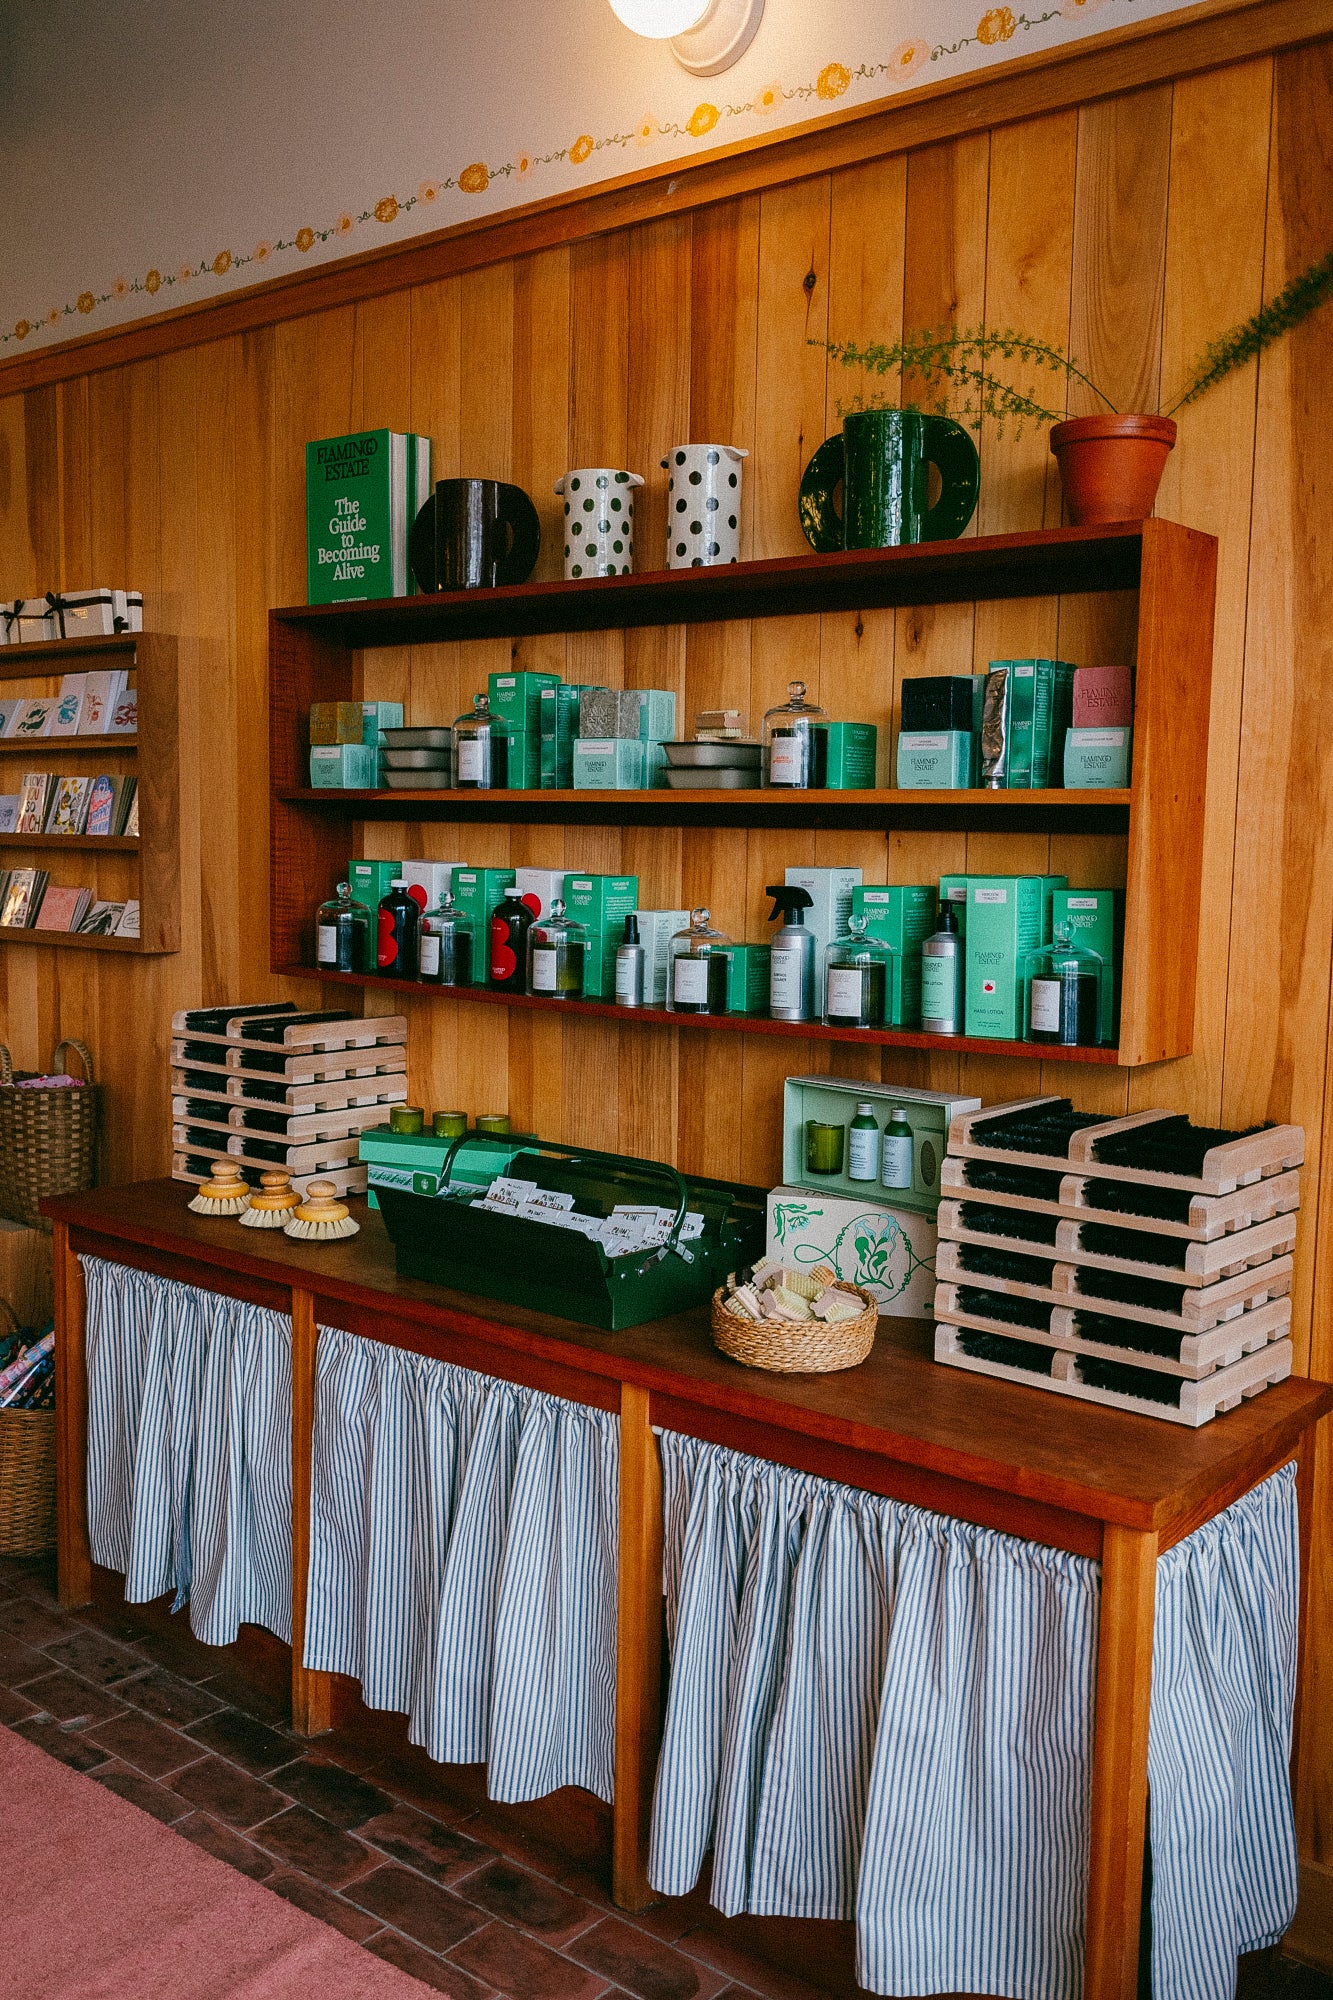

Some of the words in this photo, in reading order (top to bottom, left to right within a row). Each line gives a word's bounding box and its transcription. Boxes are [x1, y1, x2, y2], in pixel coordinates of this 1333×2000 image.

[316, 438, 378, 464] FLAMINGO
[325, 458, 370, 481] ESTATE
[334, 497, 359, 515] The
[328, 514, 366, 535] Guide
[341, 533, 354, 548] to
[317, 544, 380, 565] Becoming
[332, 563, 365, 581] Alive
[1087, 697, 1120, 708] ESTATE
